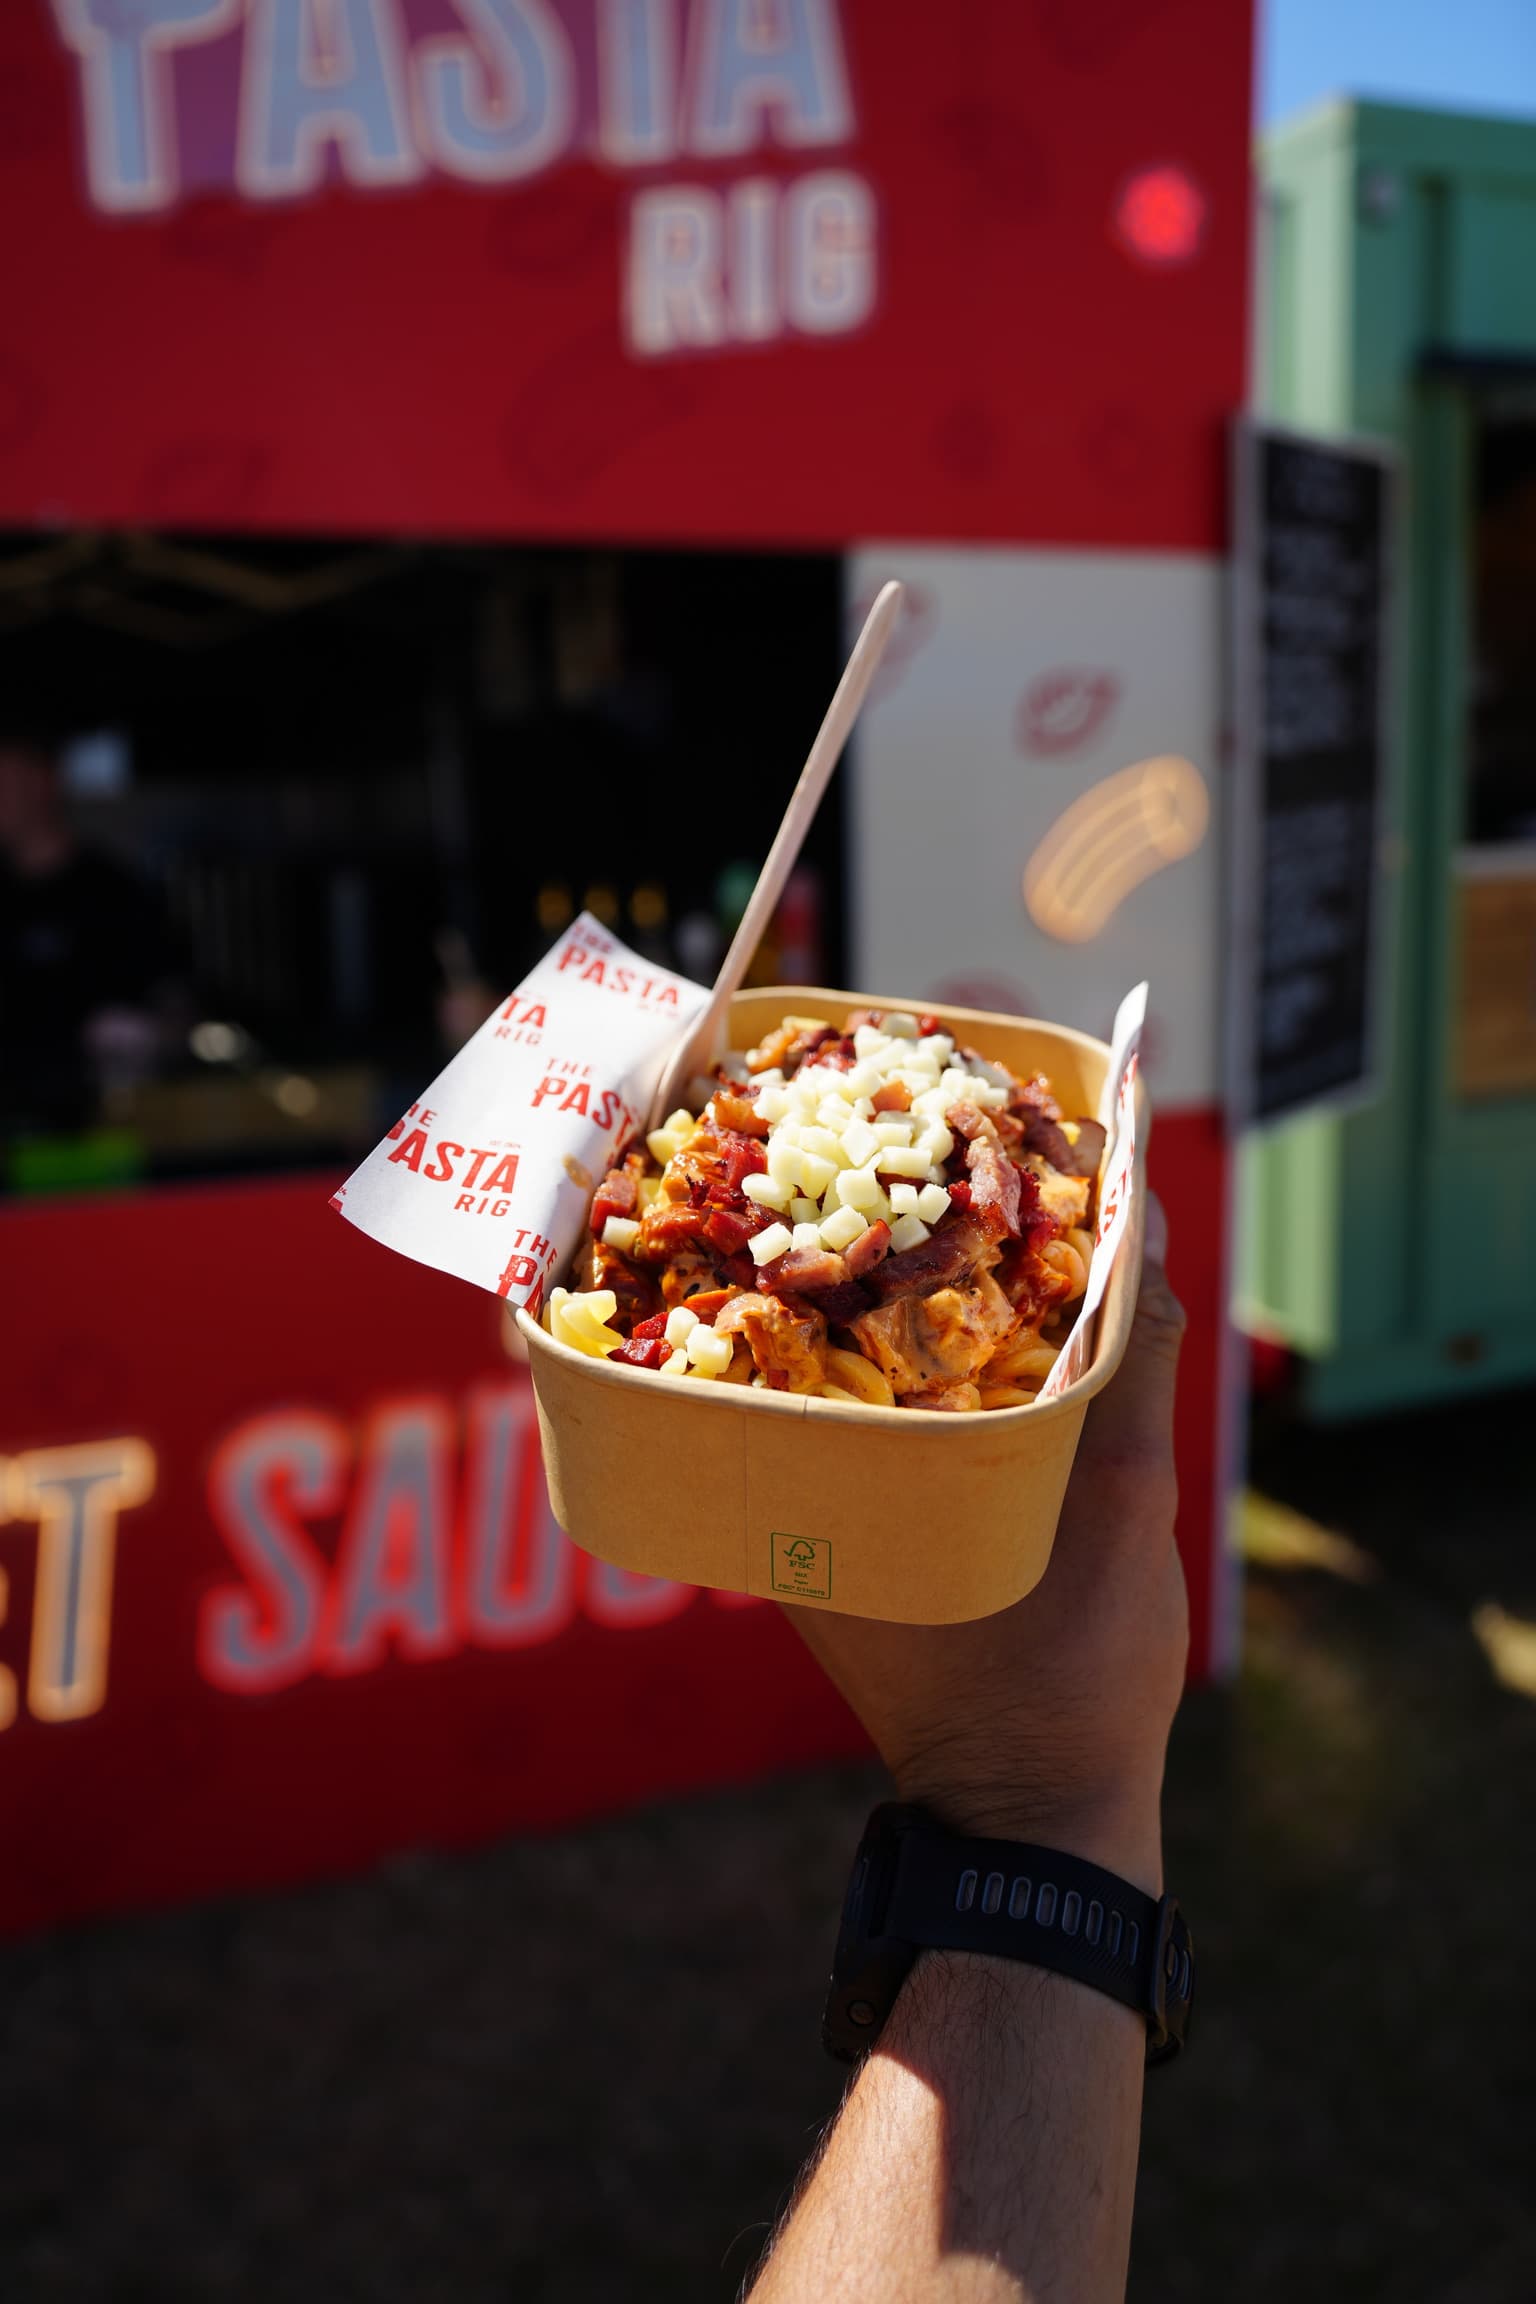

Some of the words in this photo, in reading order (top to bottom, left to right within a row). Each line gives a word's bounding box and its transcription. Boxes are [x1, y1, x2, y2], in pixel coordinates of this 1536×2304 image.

[624, 170, 877, 358] RIG
[557, 942, 680, 1006] PASTA
[494, 1025, 543, 1045] RIG
[546, 1057, 595, 1077] THE
[530, 1076, 638, 1147] PAST
[454, 1193, 511, 1217] RIG
[514, 1229, 558, 1273] THE
[199, 1386, 765, 1695] SAU
[788, 1559, 816, 1570] FSC
